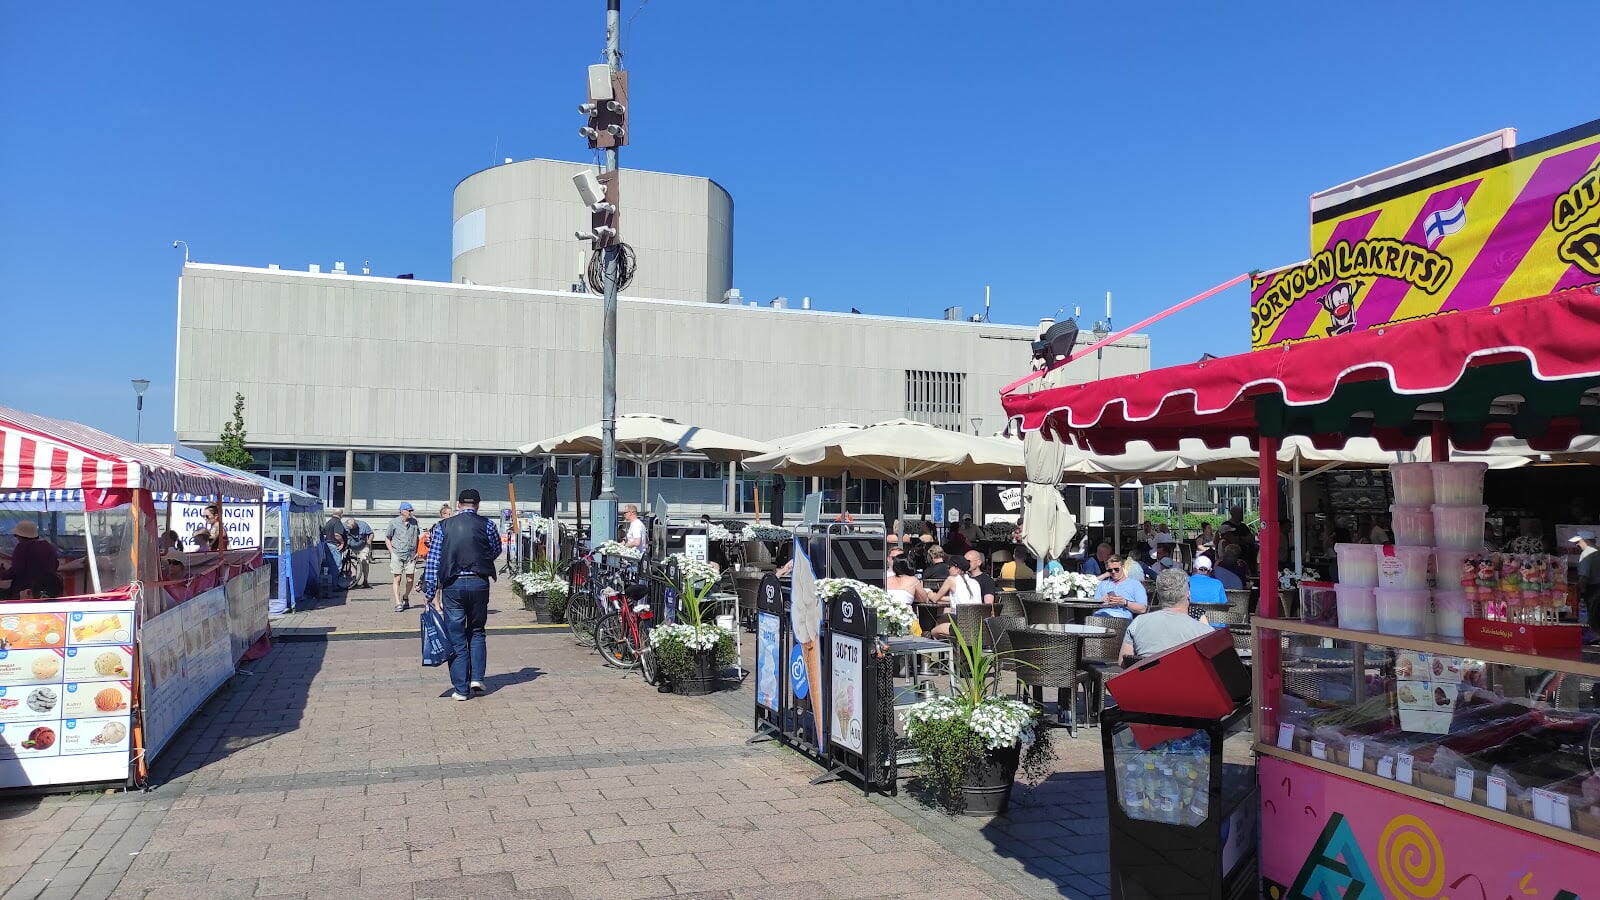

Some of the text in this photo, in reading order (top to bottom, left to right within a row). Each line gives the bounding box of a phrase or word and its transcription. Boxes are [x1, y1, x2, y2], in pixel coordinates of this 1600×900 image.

[1559, 176, 1600, 225] AIT
[1340, 245, 1446, 287] LAKRITSI
[182, 507, 254, 518] KAUNGIN
[835, 642, 858, 664] SOFTIS
